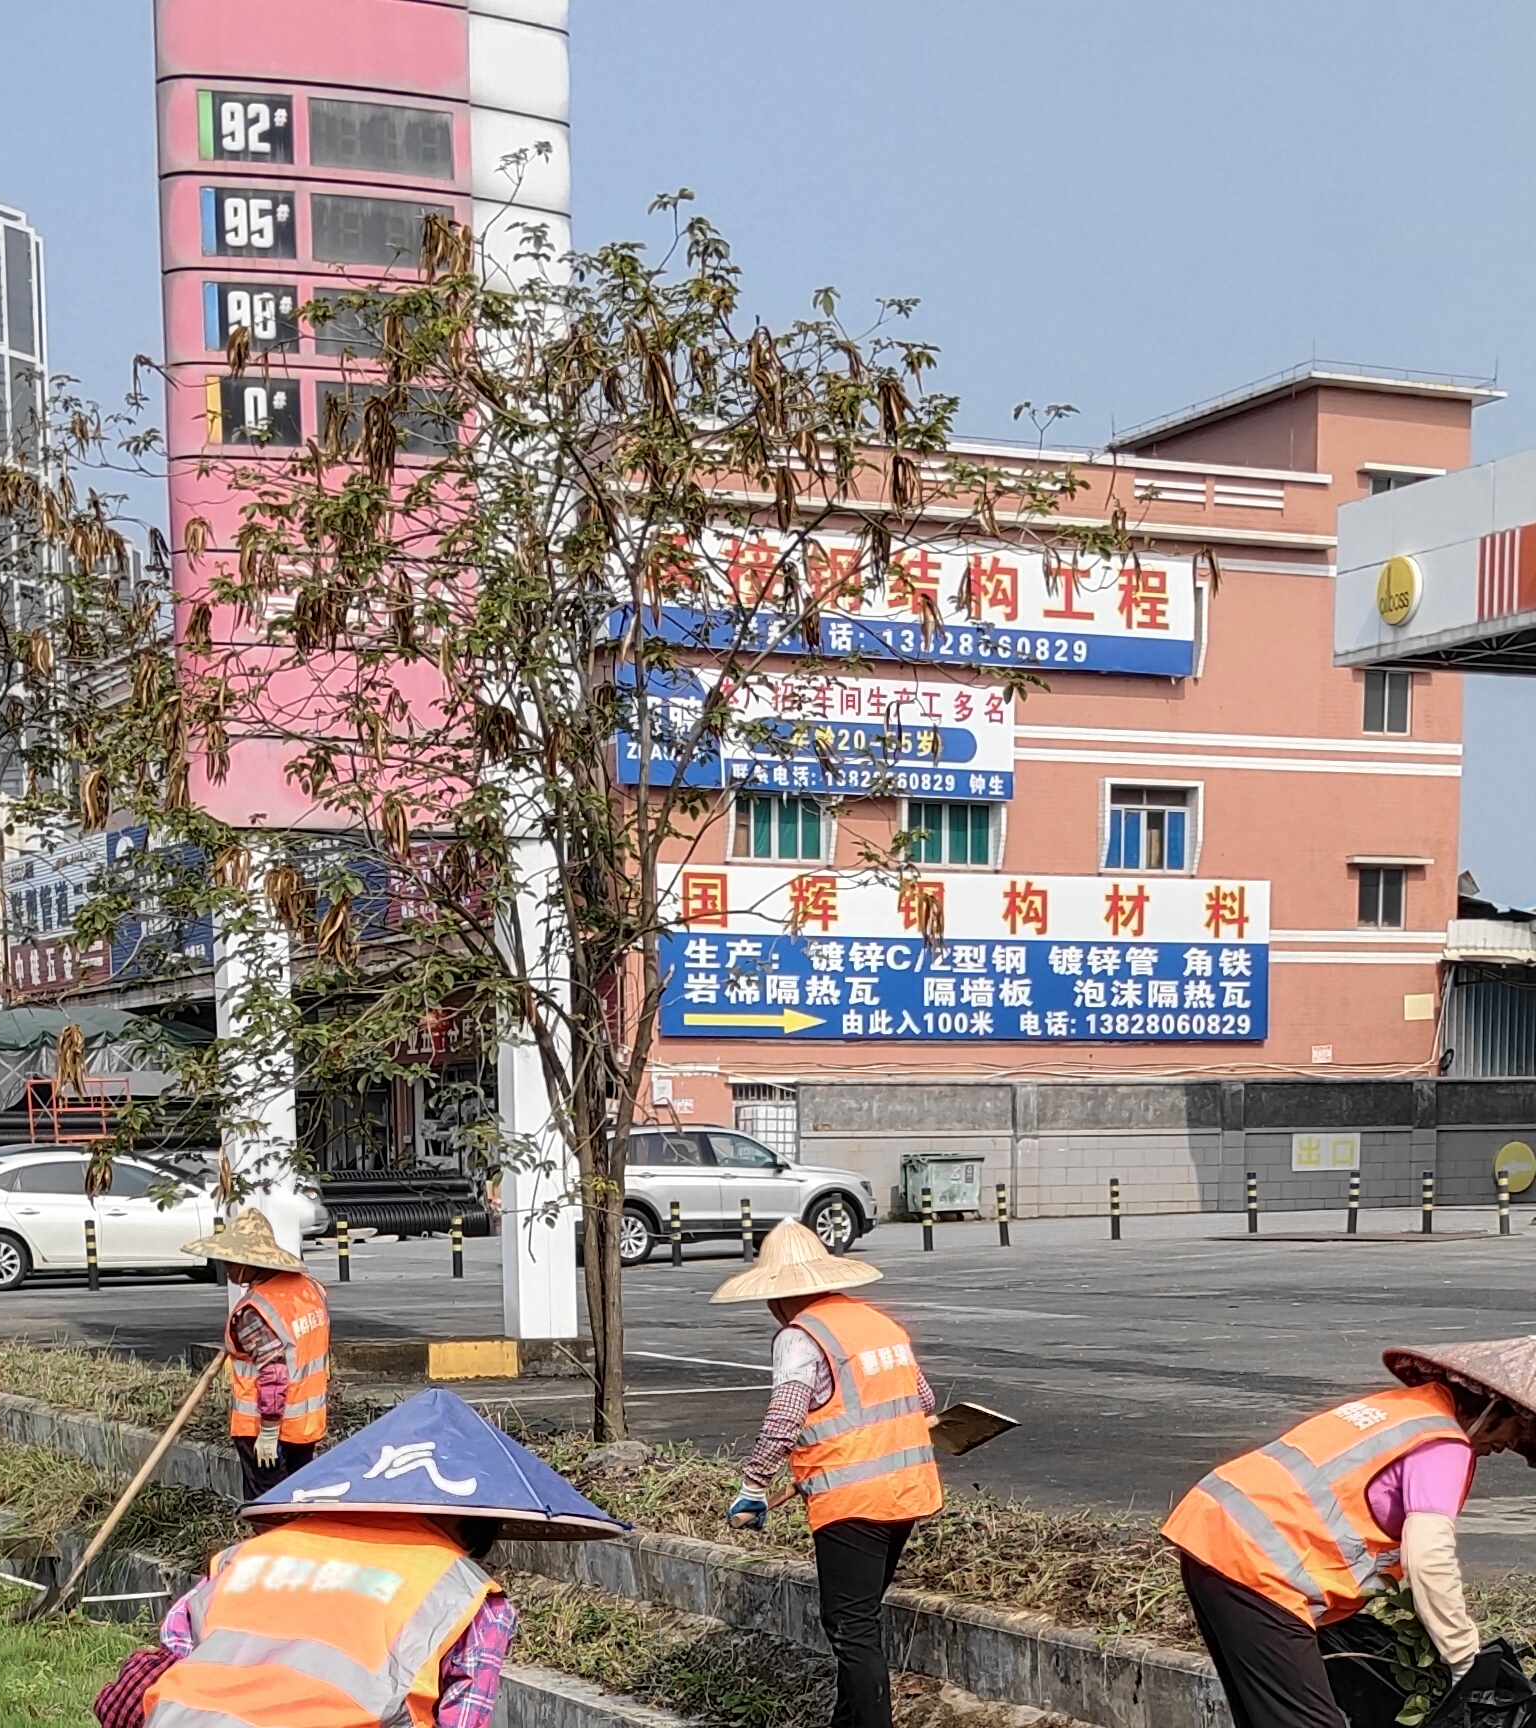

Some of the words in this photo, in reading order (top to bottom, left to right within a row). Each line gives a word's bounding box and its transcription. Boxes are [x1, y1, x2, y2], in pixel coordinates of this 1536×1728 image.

[969, 773, 1006, 796] 钟生
[682, 871, 1250, 939] 国辉钢构材料
[1048, 945, 1160, 977] 镀锌管
[1182, 946, 1253, 978] 角铁
[683, 972, 880, 1006] 岩棉隔热瓦
[922, 976, 1034, 1008] 隔墙板
[1073, 980, 1252, 1010] 泡沫隔热瓦
[841, 1009, 994, 1036] 由此入100米
[1019, 1011, 1077, 1036] 电话:
[1085, 1013, 1252, 1036] 13828060829
[1296, 1135, 1355, 1166] 出口
